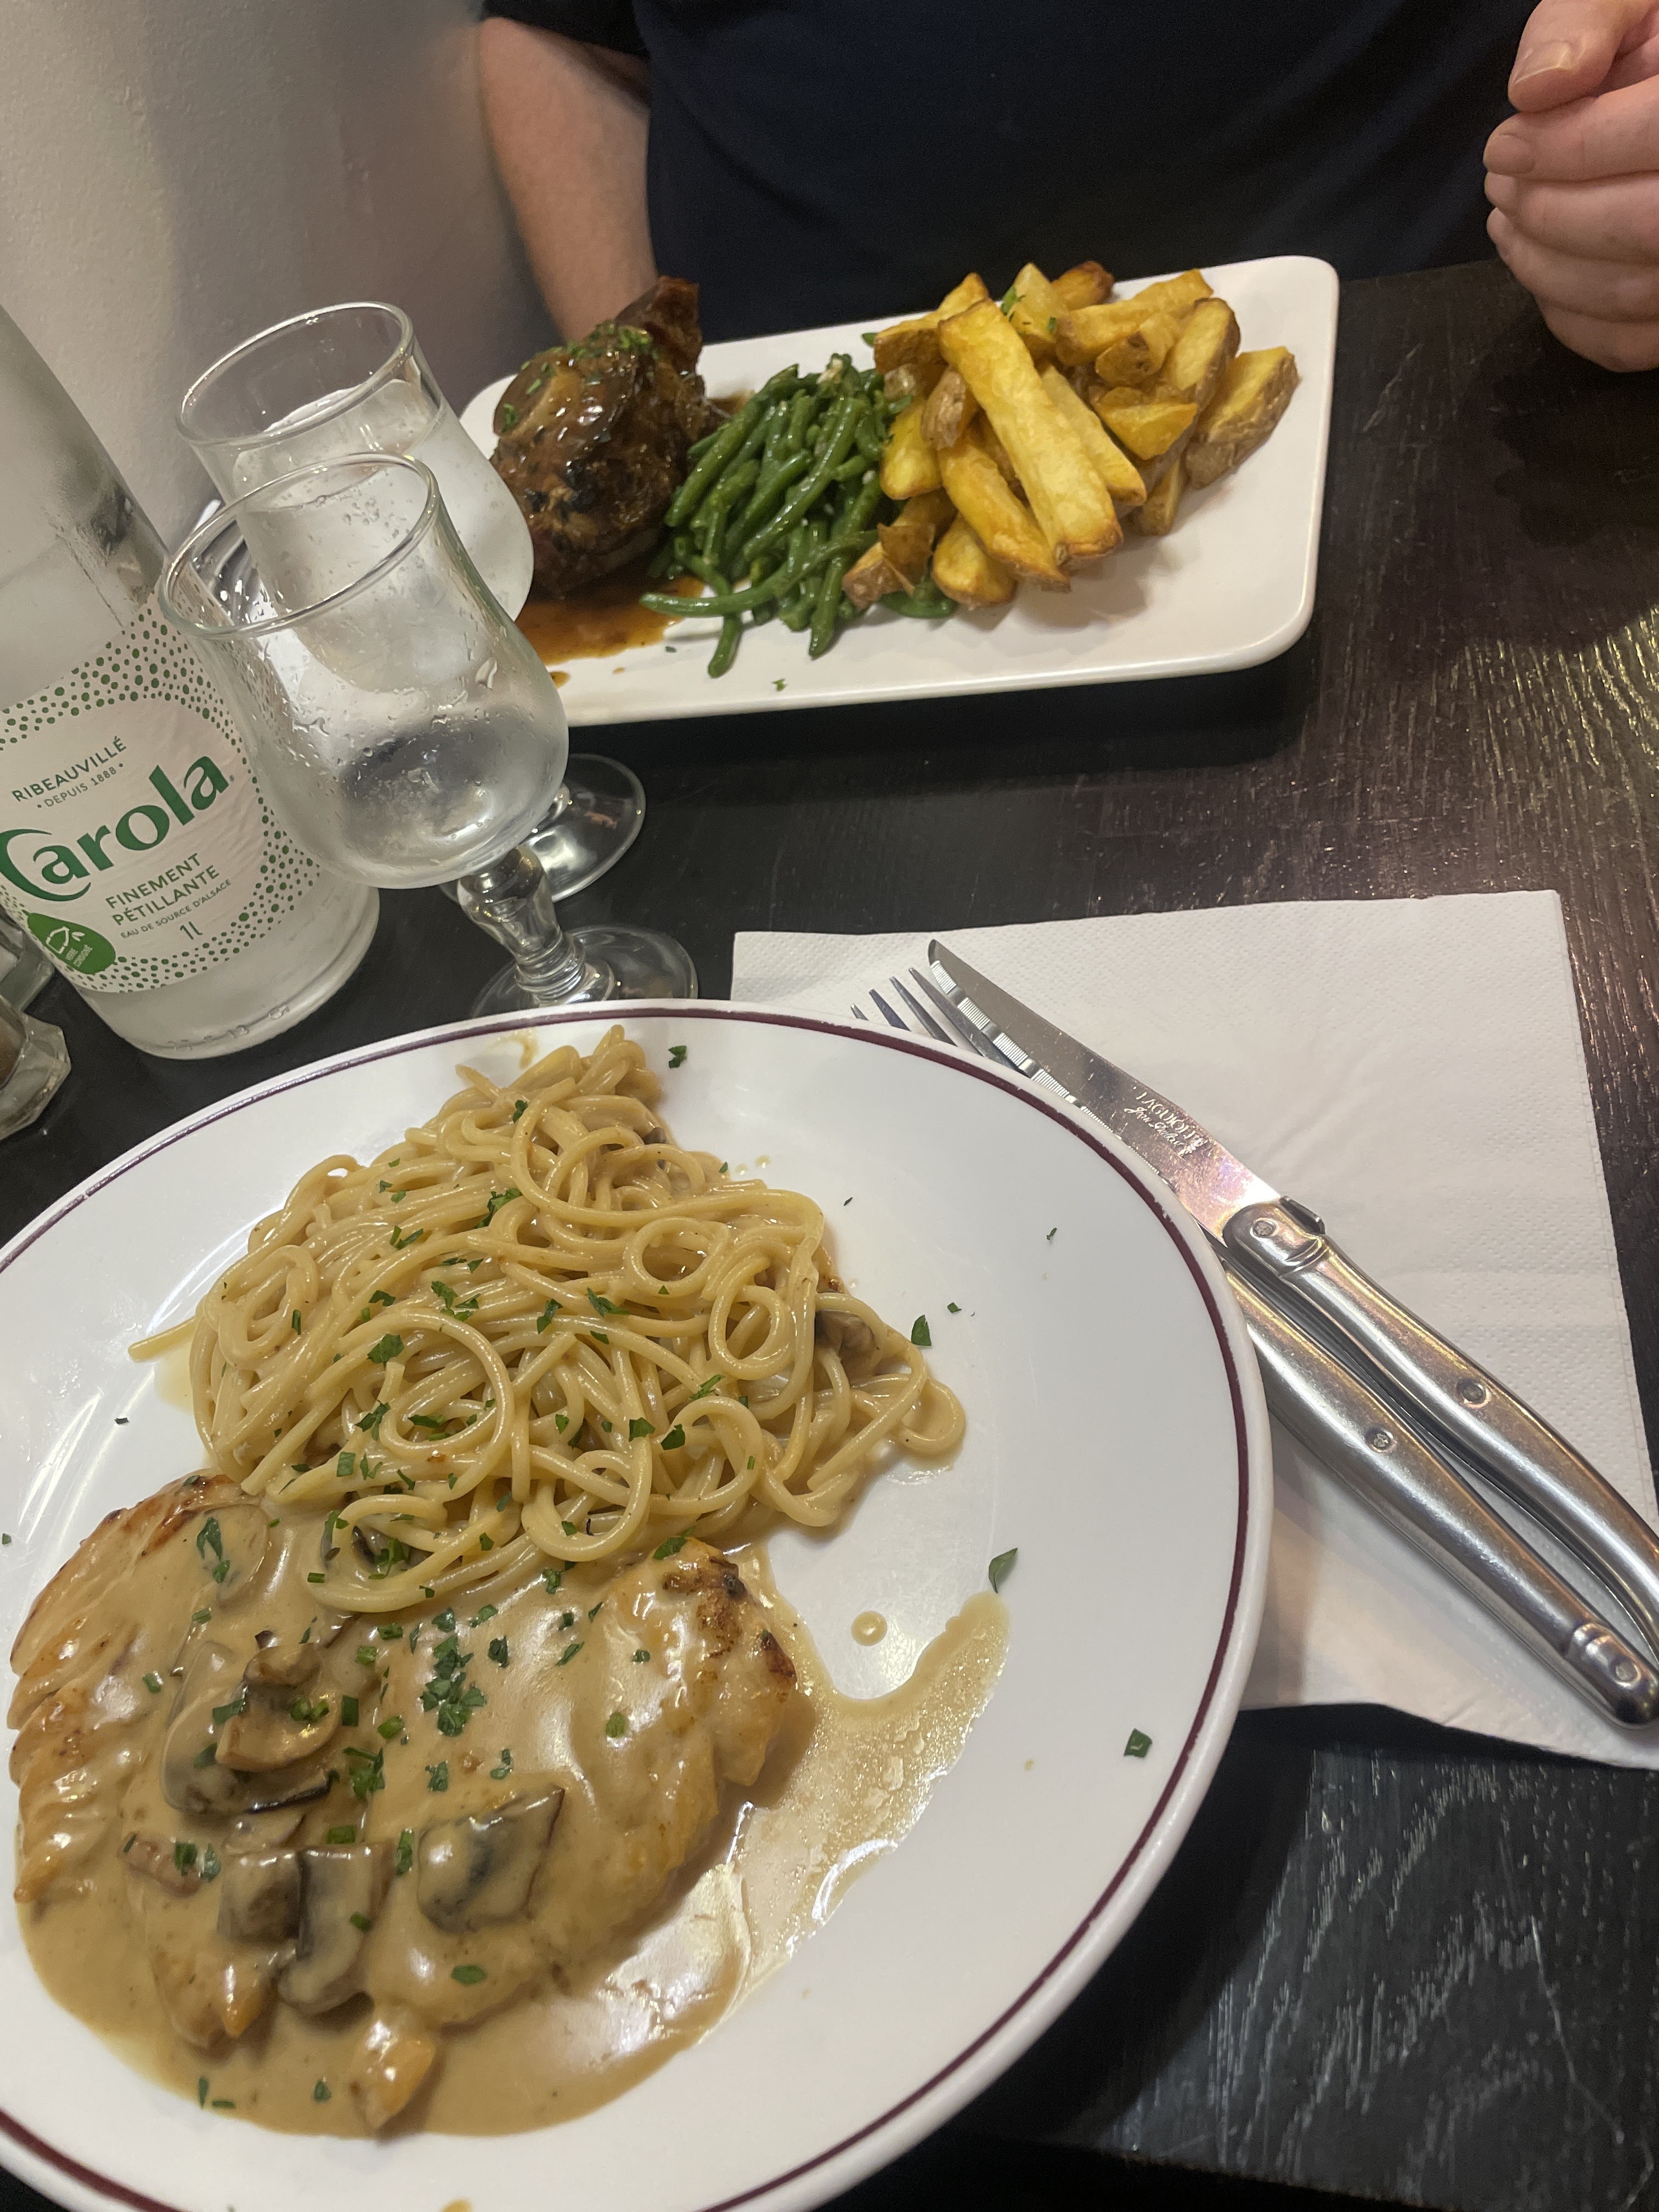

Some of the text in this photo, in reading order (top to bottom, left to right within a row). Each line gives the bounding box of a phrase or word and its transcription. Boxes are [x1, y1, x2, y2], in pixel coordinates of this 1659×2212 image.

[12, 736, 127, 802] RIBEAUVILLÉ
[44, 767, 117, 807] DEPUIS 1888
[0, 756, 229, 902] Carola
[105, 853, 200, 909] FINEMENT
[112, 865, 219, 926] PÉTILLANTE
[120, 879, 232, 938] EAU DE SOURCE D'ALSACE
